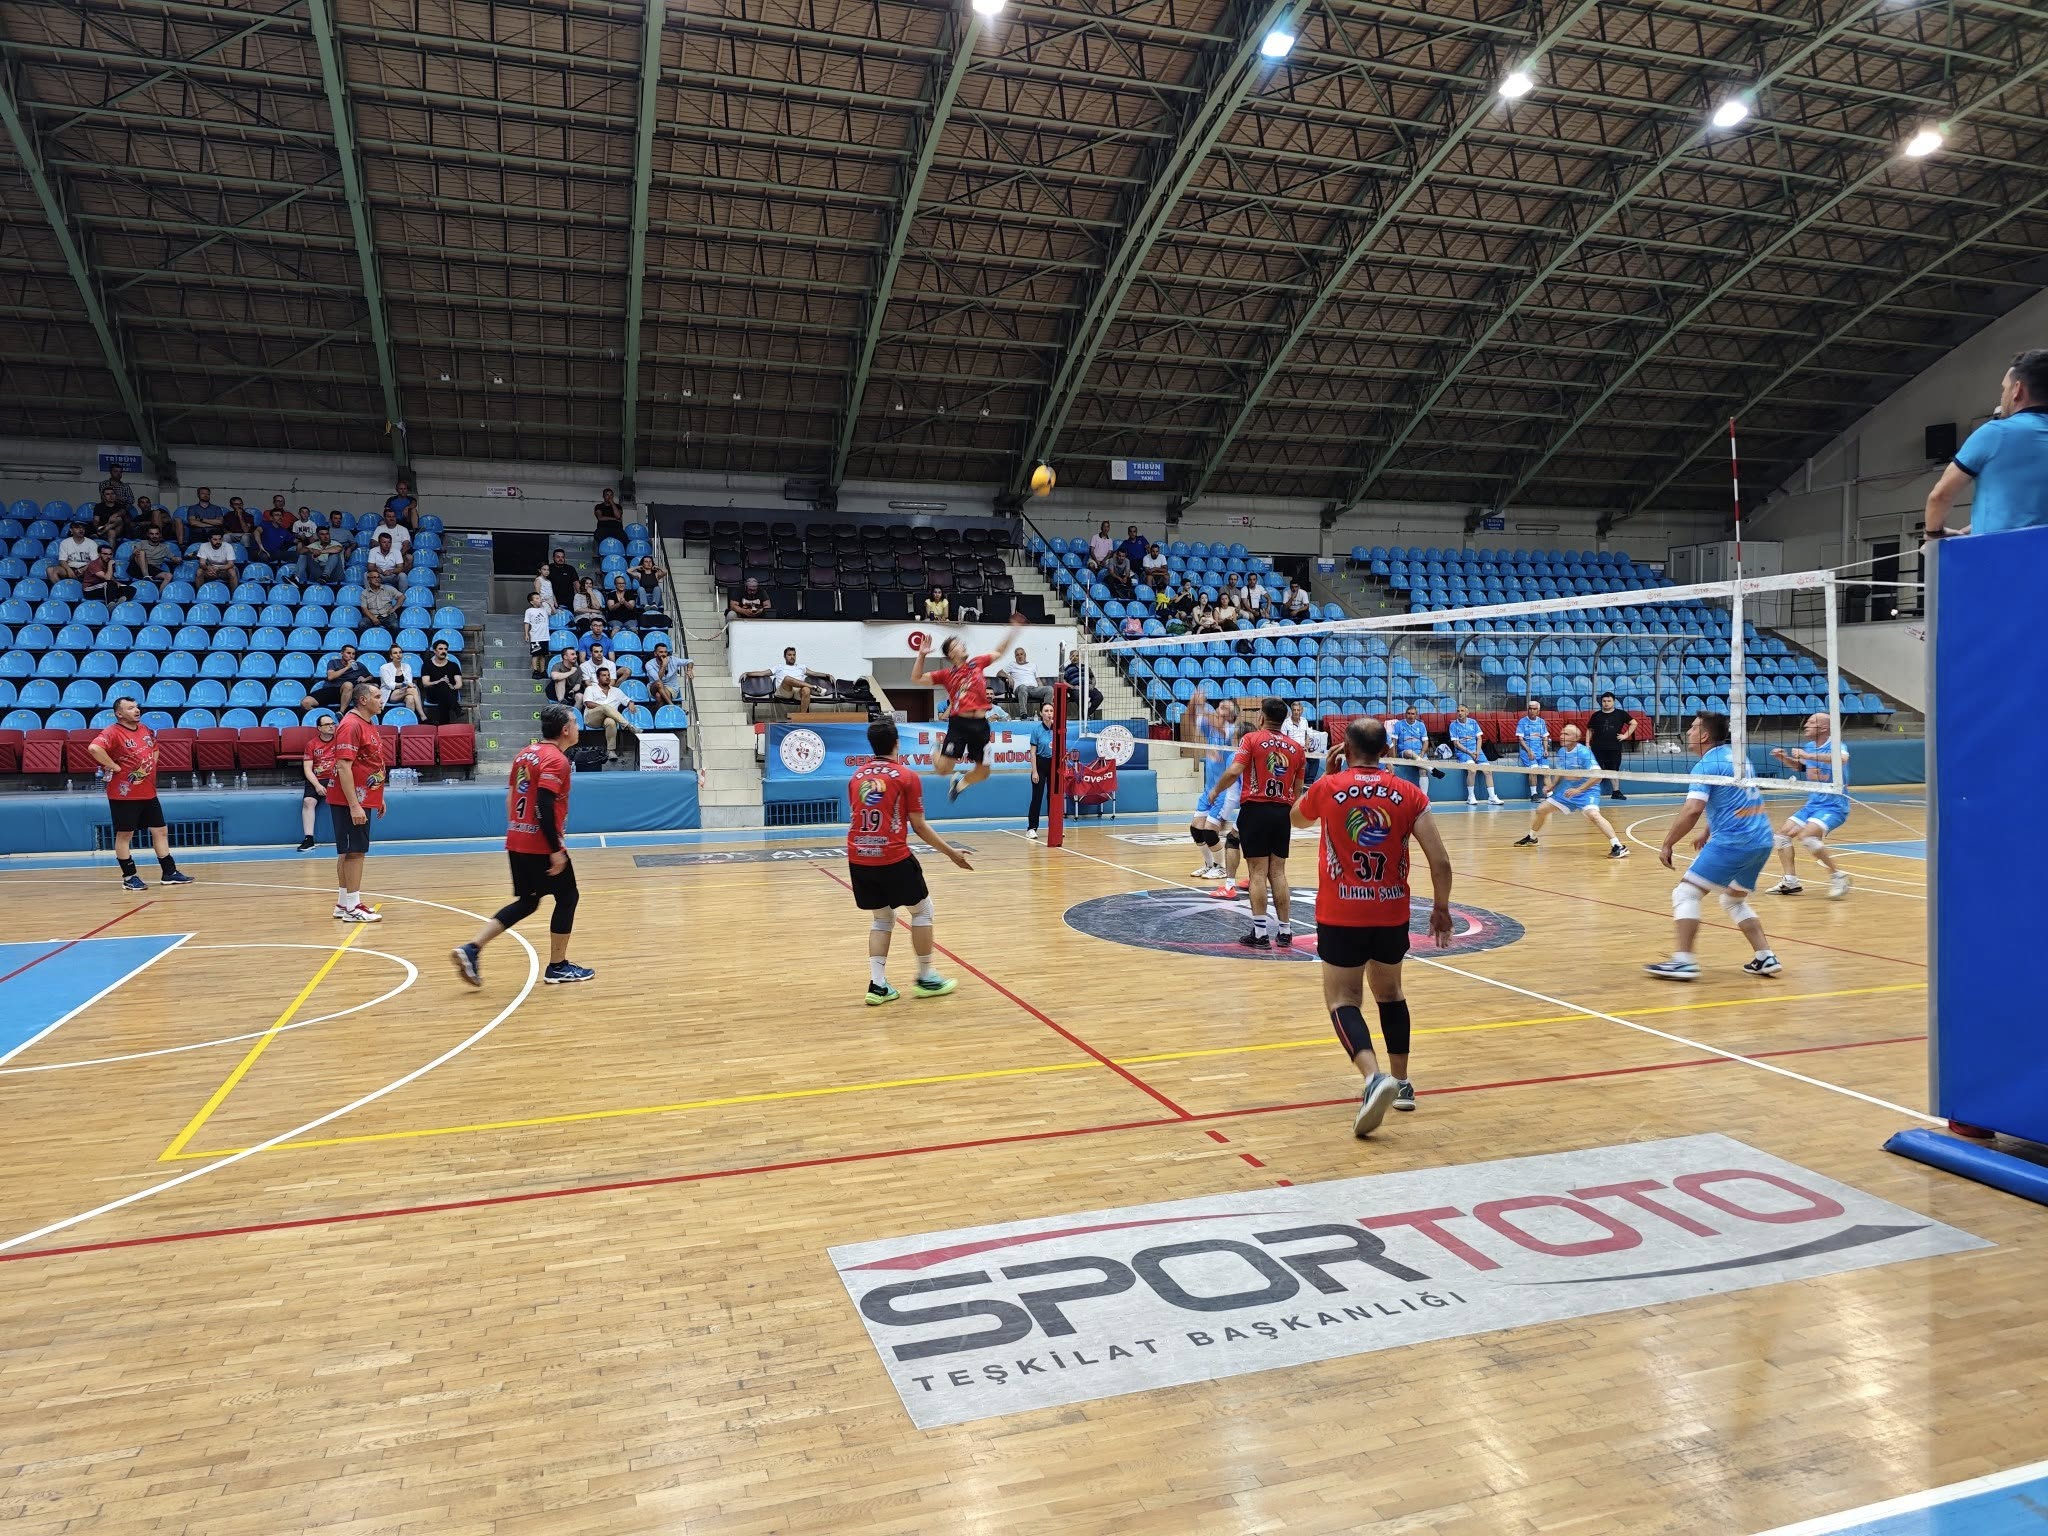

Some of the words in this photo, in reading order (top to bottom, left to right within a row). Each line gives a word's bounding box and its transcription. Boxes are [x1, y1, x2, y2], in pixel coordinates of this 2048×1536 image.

[1132, 461, 1161, 470] TRİBÜN
[913, 752, 933, 765] VE
[1333, 785, 1403, 805] DOÇEK
[516, 796, 527, 819] 4
[860, 808, 883, 833] 19
[1352, 850, 1387, 881] 37
[1339, 882, 1375, 900] İLHAN
[912, 1338, 1159, 1392] TEŞKİLAT
[1186, 1290, 1467, 1347] BAŞKANLIĞI
